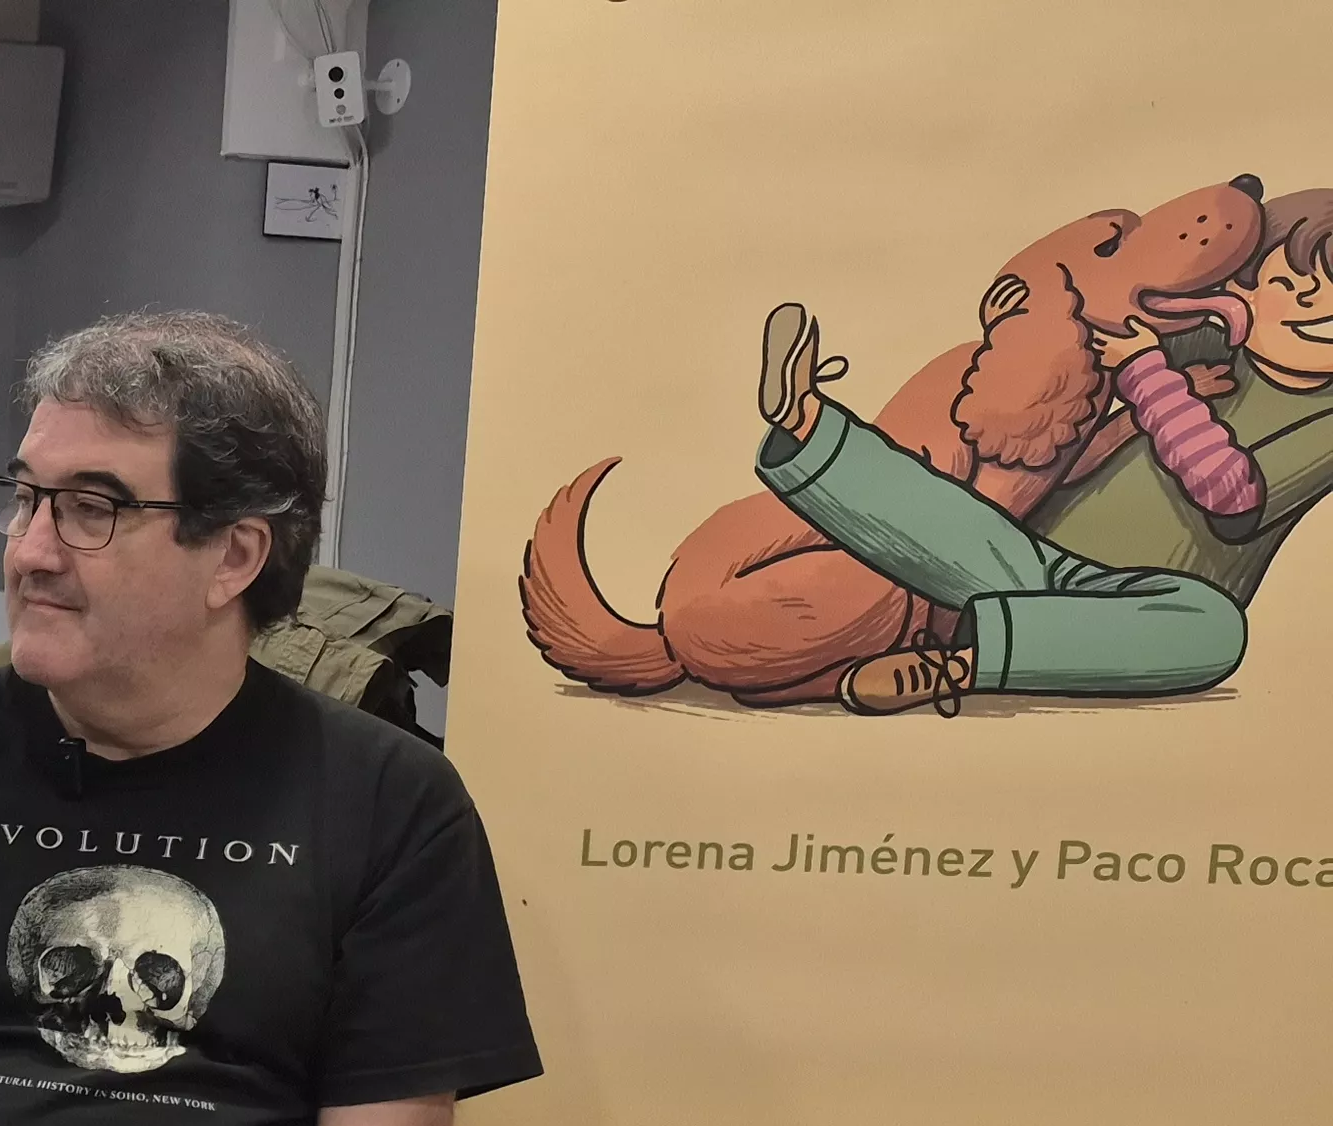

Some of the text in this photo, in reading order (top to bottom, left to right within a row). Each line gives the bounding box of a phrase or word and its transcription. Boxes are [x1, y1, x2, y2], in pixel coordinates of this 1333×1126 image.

[580, 828, 1333, 890] Lorena Jiménez y Paco Roca
[36, 1079, 92, 1096] HISTORY
[94, 1088, 108, 1098] IN
[109, 1090, 149, 1103] SOHO,
[152, 1094, 181, 1106] NEW
[184, 1098, 216, 1111] YORK
